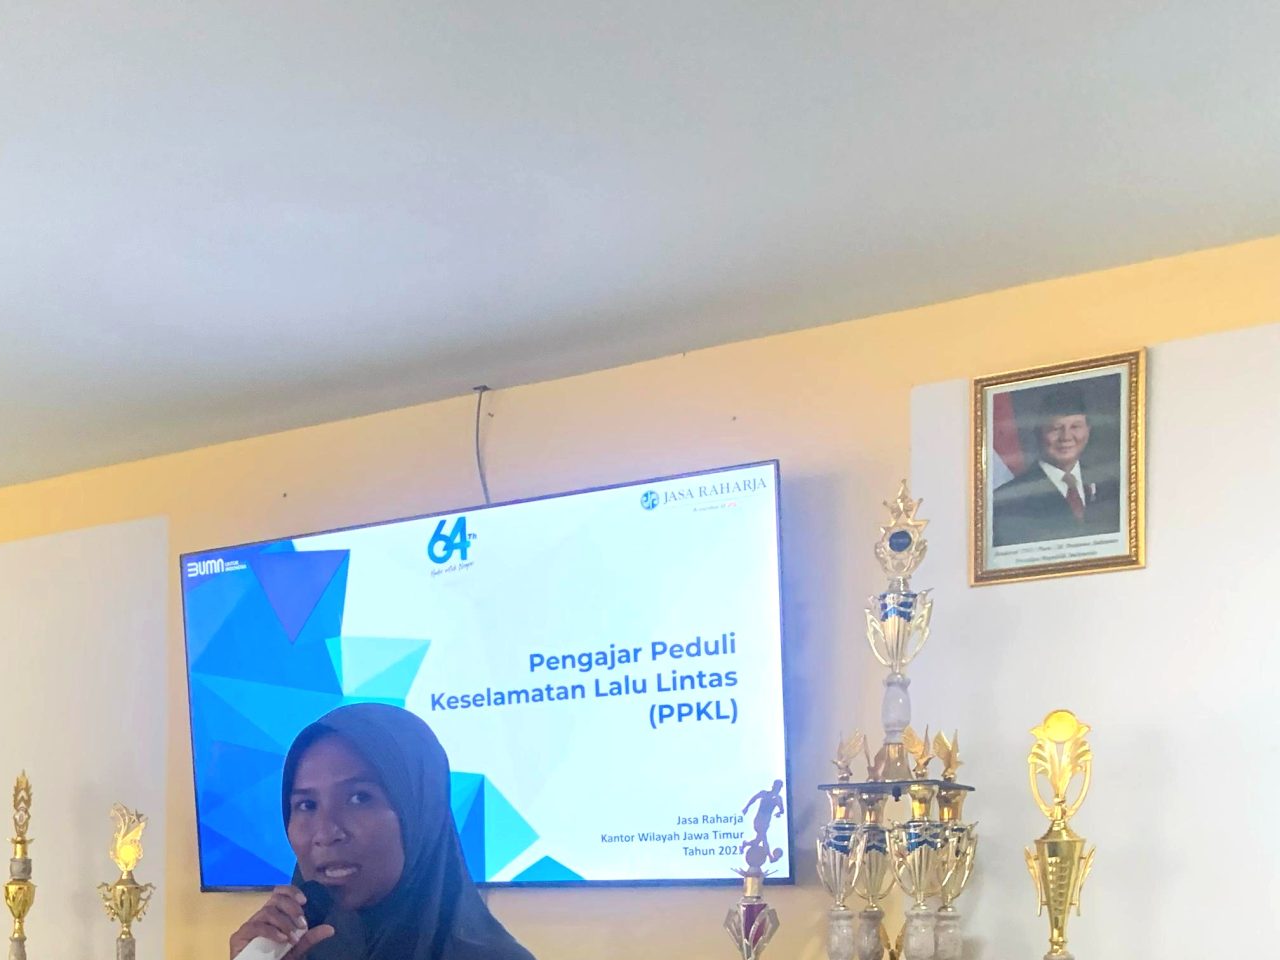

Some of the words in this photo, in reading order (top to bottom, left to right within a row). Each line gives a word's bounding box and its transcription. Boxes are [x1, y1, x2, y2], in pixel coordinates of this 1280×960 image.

[663, 488, 695, 505] JASA
[699, 477, 767, 498] RAHARJA
[529, 644, 642, 673] Pengajar
[651, 631, 737, 661] Peduli
[431, 683, 585, 712] Keselamatan
[594, 674, 647, 698] Lalu
[657, 669, 738, 692] Lintas
[649, 698, 738, 729] (PPKL)
[677, 815, 699, 825] Jasa
[702, 813, 744, 826] Raharja
[601, 833, 635, 843] Kantor
[638, 831, 680, 844] Wilayah
[683, 831, 709, 841] Jawa
[712, 830, 744, 840] Timur
[683, 846, 715, 856] Tahun
